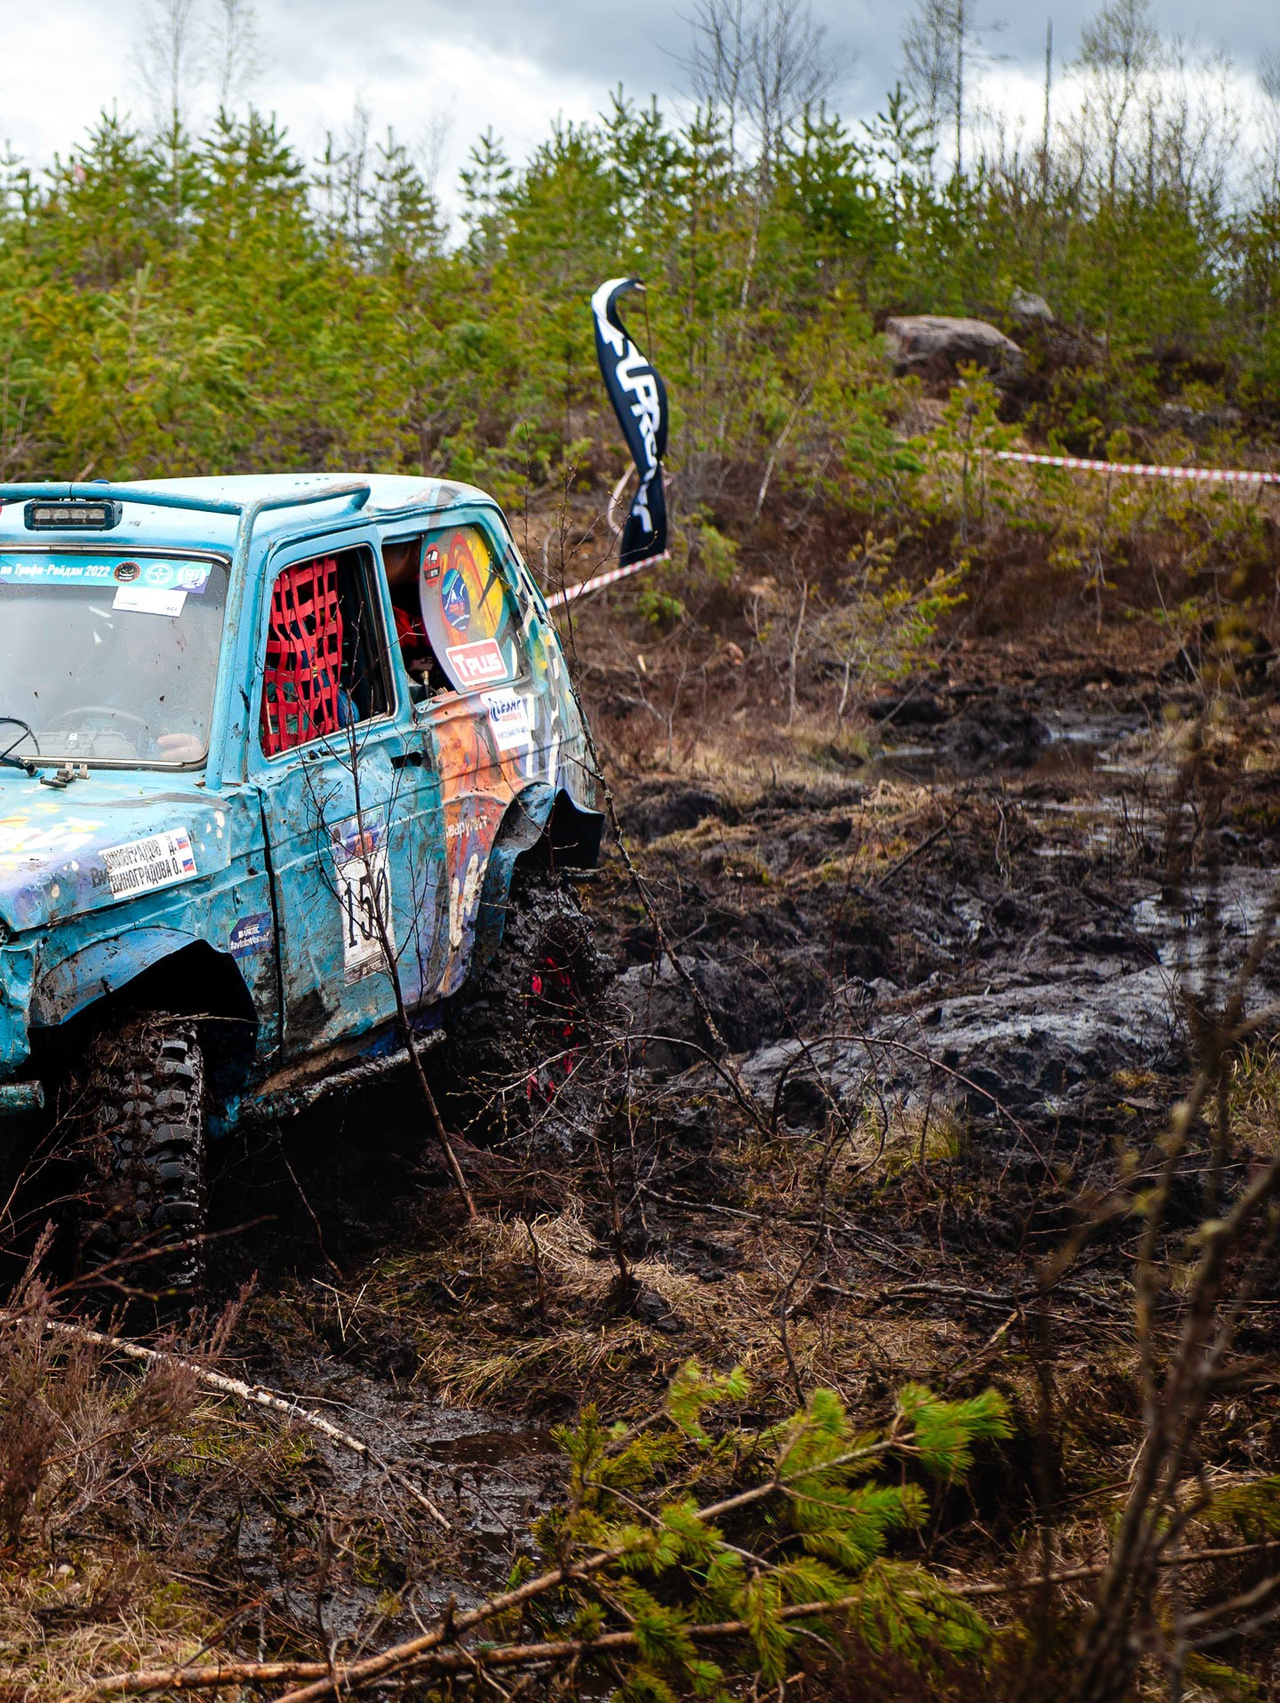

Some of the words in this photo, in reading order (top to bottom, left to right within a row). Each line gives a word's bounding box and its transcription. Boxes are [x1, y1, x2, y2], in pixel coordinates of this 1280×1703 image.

[1, 565, 13, 575] по
[15, 563, 83, 578] Трофи-Рейдам
[84, 565, 111, 578] 2022
[102, 839, 162, 868] ВИНОГРАДОВ
[110, 859, 172, 894] ВИНОГРАДОВА
